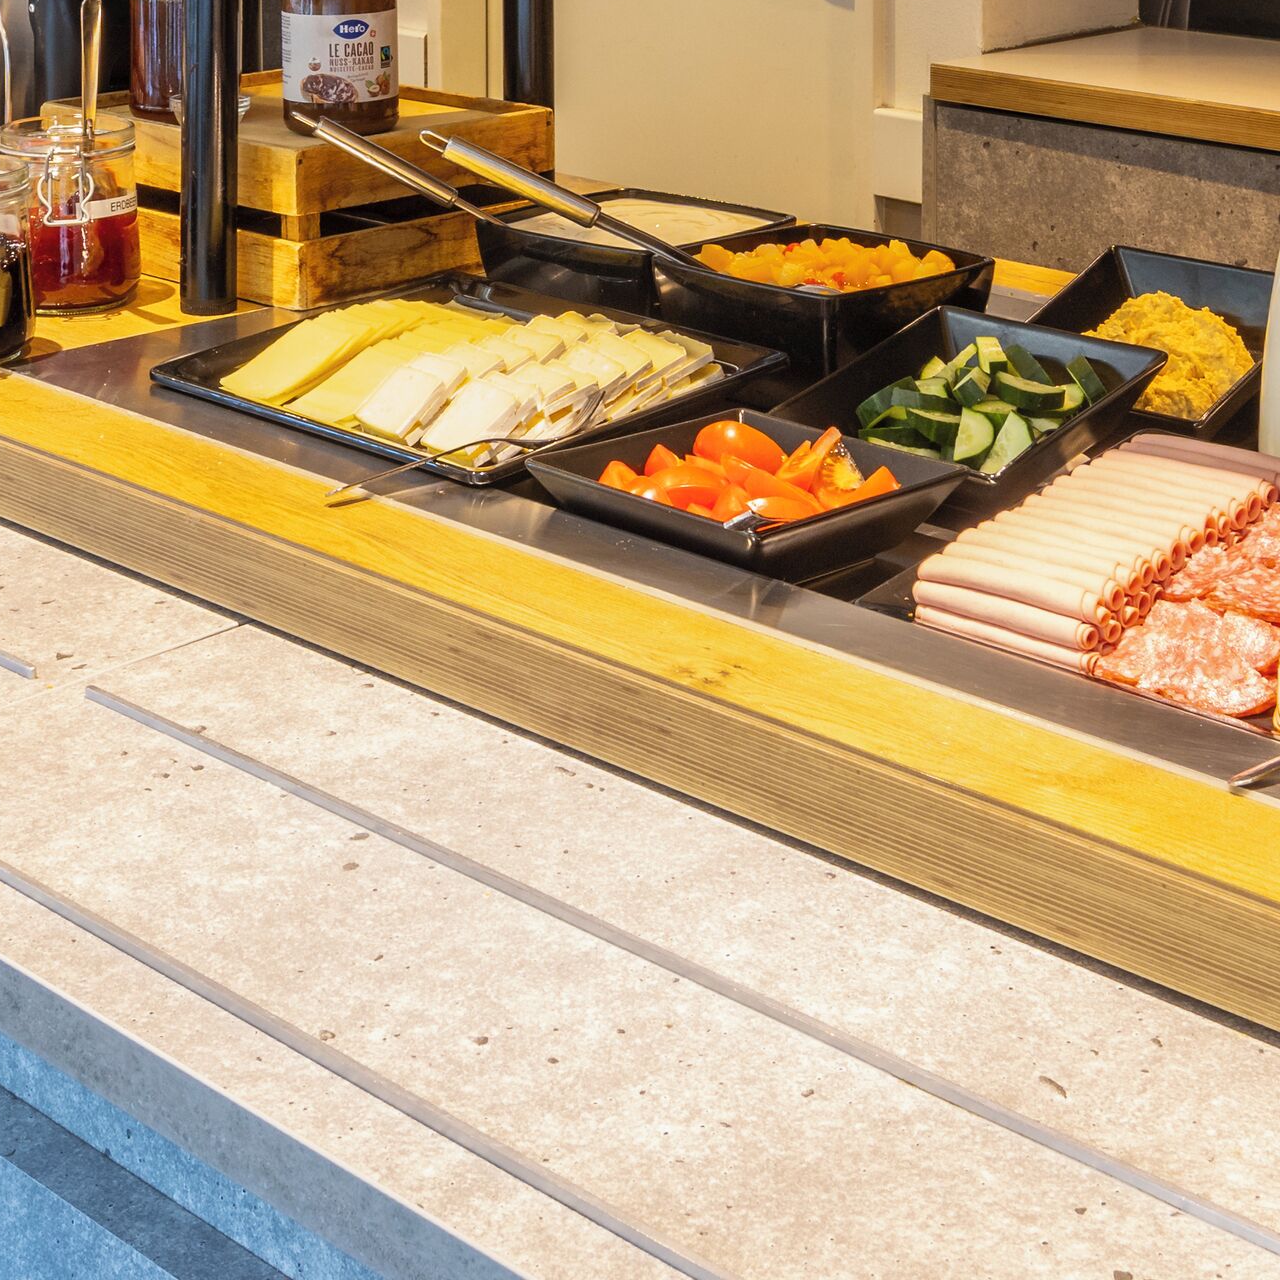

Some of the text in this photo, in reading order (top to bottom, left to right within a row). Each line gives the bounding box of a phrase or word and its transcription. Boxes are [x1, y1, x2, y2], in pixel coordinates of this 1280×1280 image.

[339, 23, 366, 34] Hero
[329, 41, 374, 58] LE CACAO
[329, 56, 374, 67] NUSS-KAKAO
